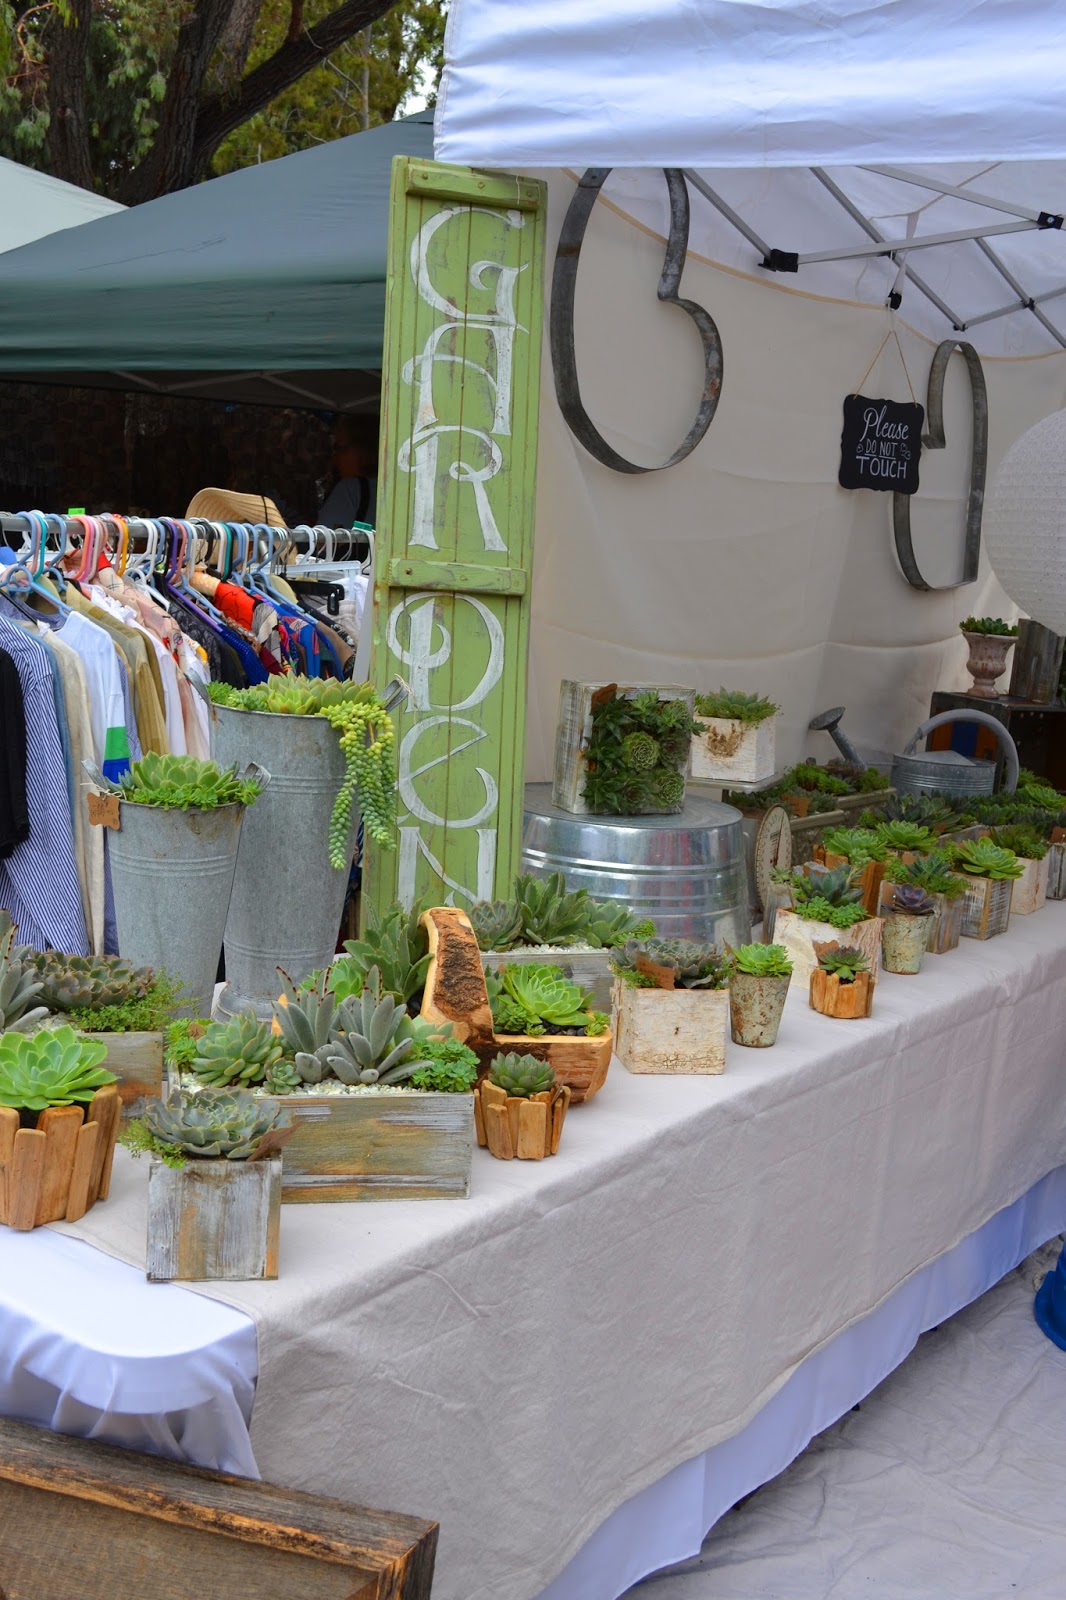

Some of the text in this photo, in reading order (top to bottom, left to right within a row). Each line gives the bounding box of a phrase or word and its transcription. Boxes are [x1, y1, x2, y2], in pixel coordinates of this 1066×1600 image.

[860, 405, 909, 442] Please
[865, 439, 898, 457] DO NOT
[856, 455, 907, 479] TOUCH
